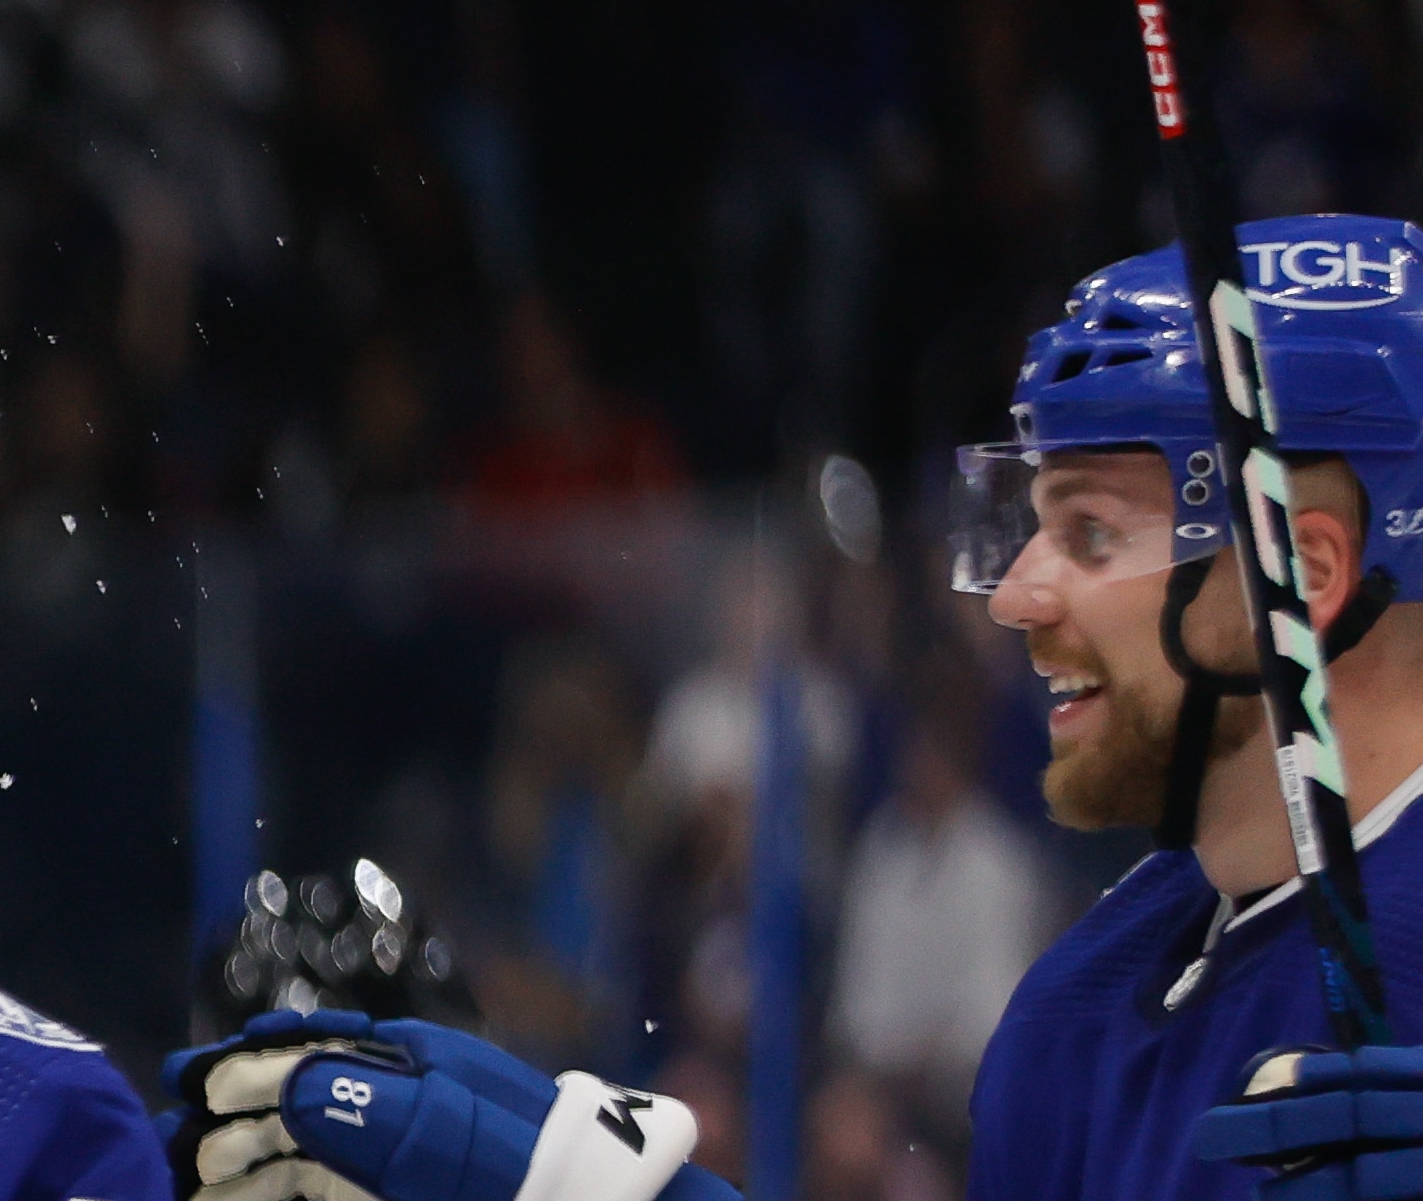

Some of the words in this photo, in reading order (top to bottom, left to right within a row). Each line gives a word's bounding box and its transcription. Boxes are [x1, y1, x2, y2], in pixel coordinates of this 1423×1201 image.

[1136, 2, 1180, 127] CCM
[1239, 240, 1403, 296] TGH
[1209, 280, 1345, 797] CCM
[324, 1076, 372, 1128] 81
